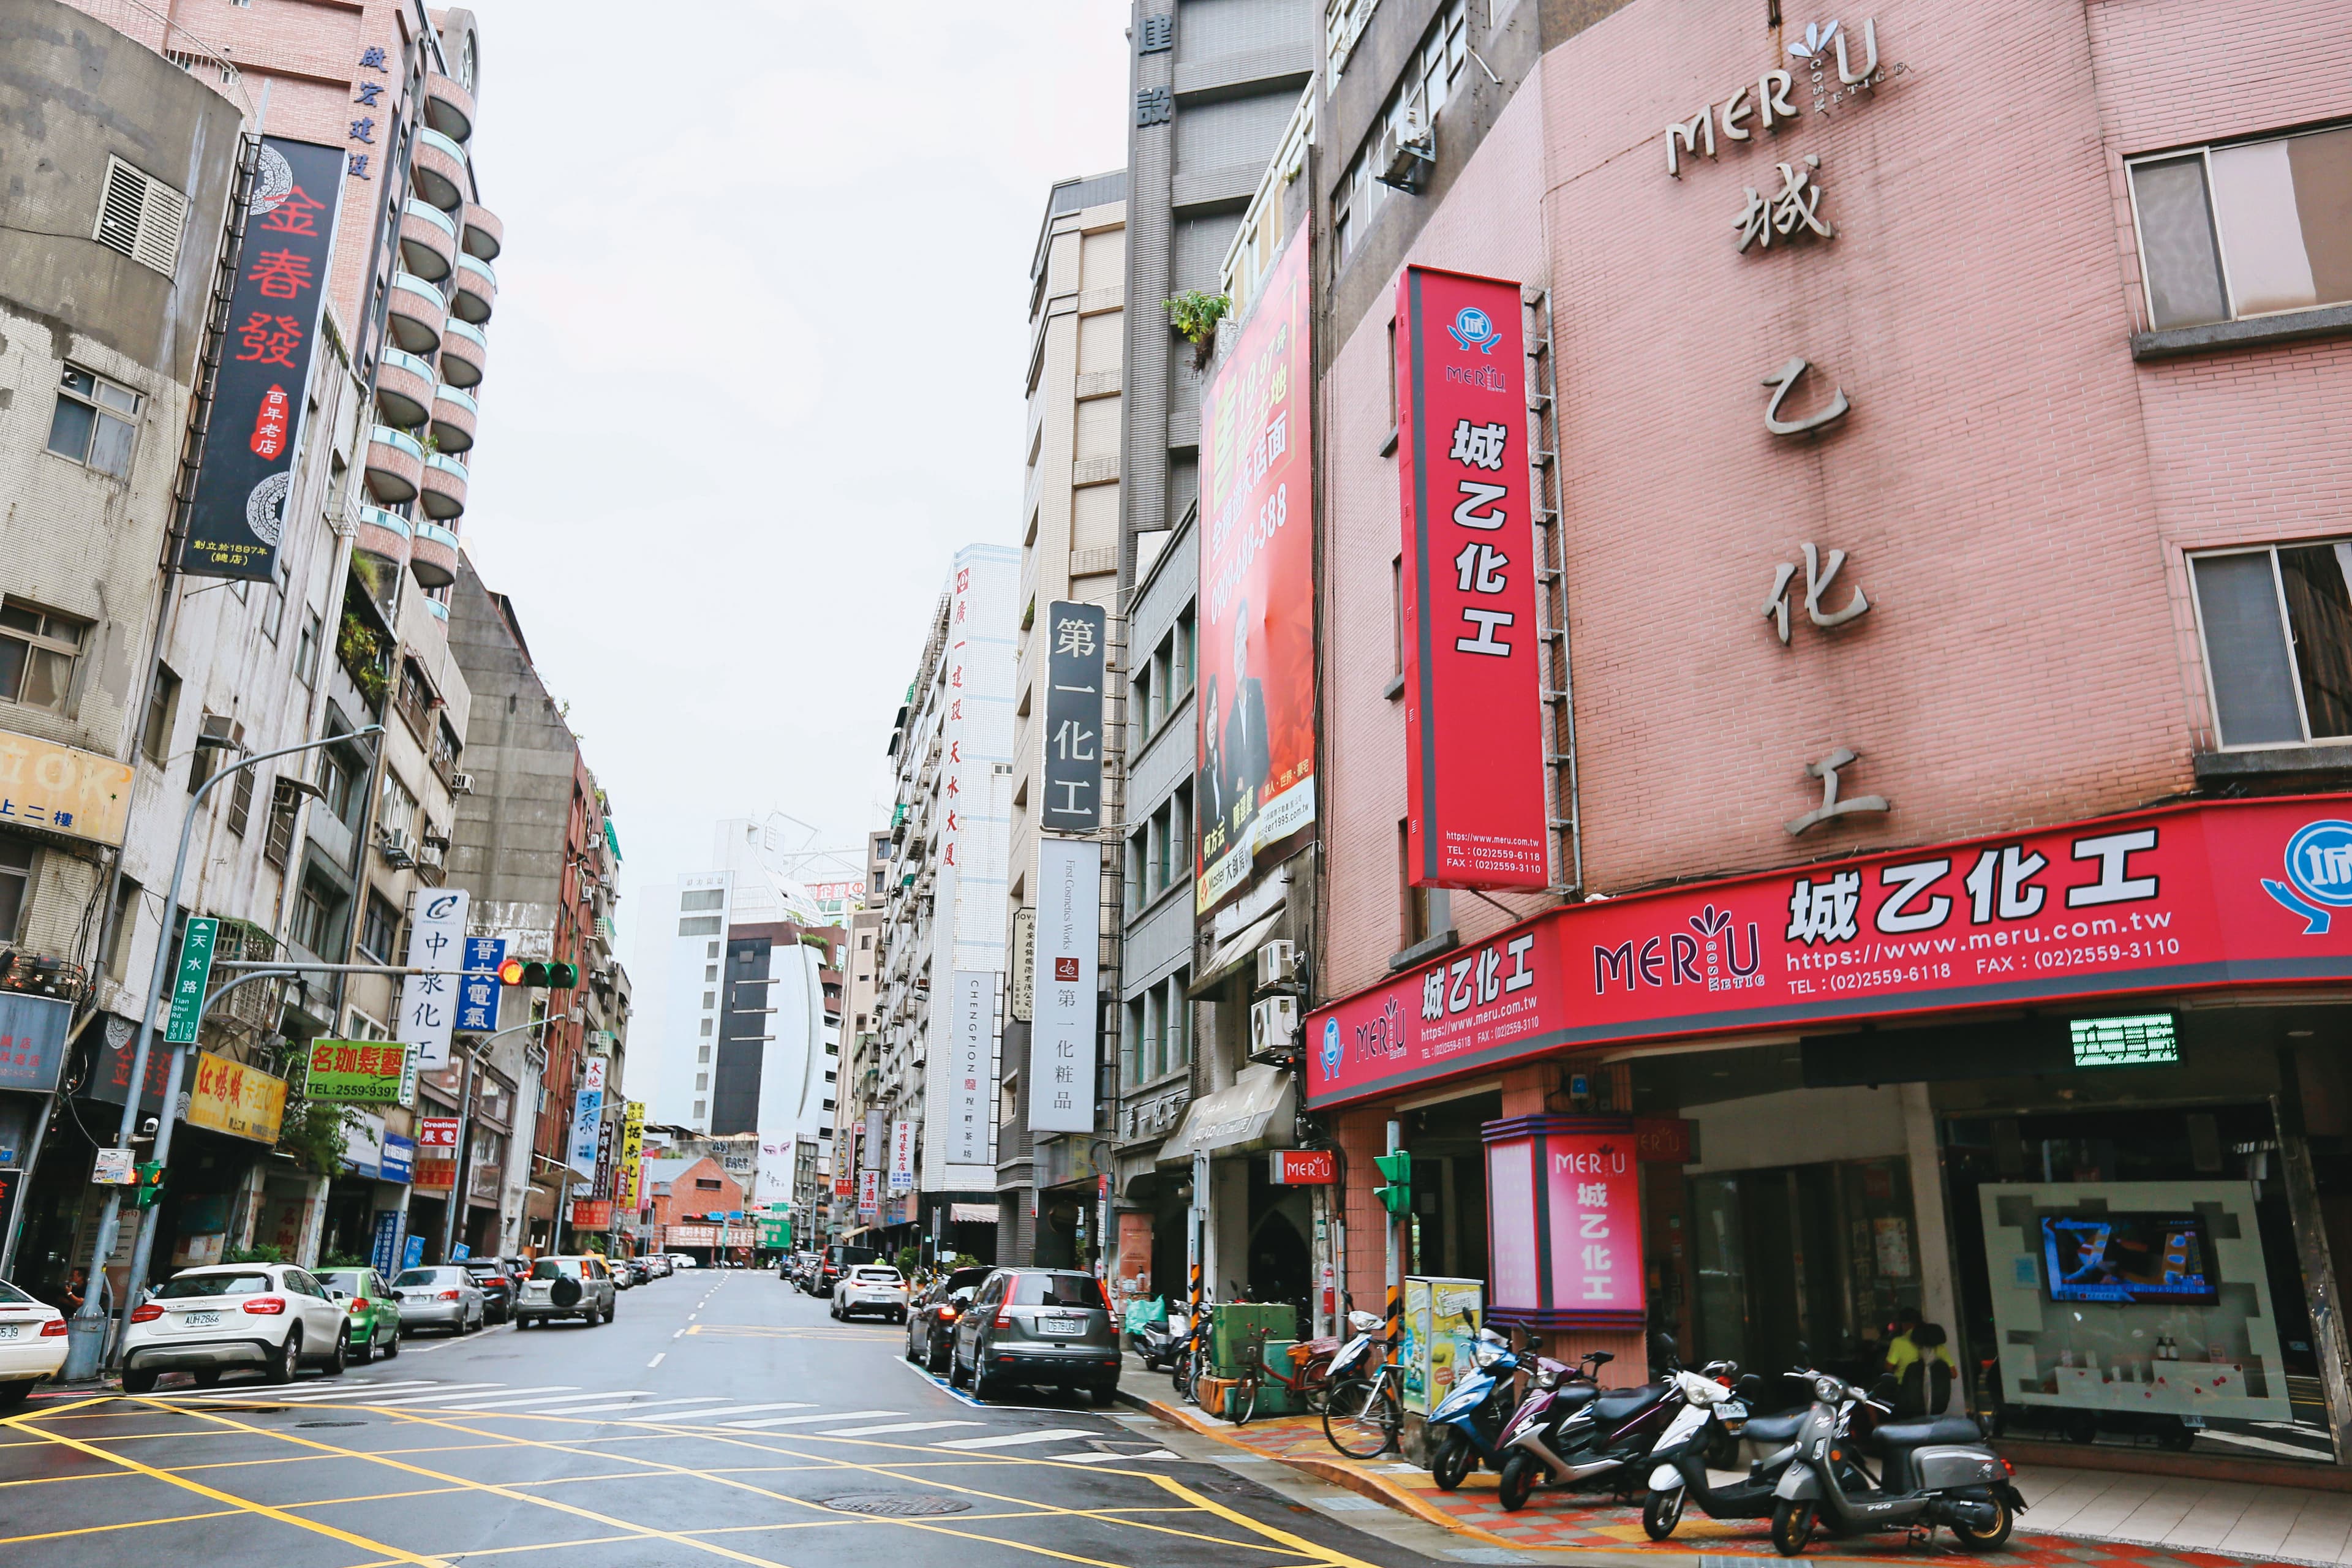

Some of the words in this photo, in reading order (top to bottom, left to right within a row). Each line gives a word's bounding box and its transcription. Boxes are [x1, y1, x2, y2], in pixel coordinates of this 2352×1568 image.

[236, 185, 328, 369] 金春發
[256, 390, 288, 454] 百年老店
[1210, 483, 1287, 626] 0909-688-588
[1449, 419, 1515, 658] 城乙化工
[1050, 617, 1097, 816] 第一化工
[942, 741, 960, 867] 天水大廈
[1066, 860, 1076, 878] First
[1446, 830, 1540, 848] https://www.meru.com.tw
[1472, 846, 1540, 862] (02)2559-6118
[1475, 859, 1541, 873] (02)2559-3110
[1063, 880, 1074, 922] Cosmetics
[1785, 827, 2160, 948] 城乙化工
[181, 934, 208, 994] 天水路
[1063, 923, 1073, 951] Works
[1786, 911, 2173, 972] https://www.meru.com.tw
[1830, 963, 1951, 993] (02)2559-6118
[2034, 937, 2180, 971] (02)2559-3110
[412, 930, 449, 1060] 中泉化工
[1421, 932, 1534, 1022] 城乙化工
[967, 980, 979, 1072] CHENGPION
[1421, 994, 1538, 1042] https://www.meru.com.tw
[1434, 1038, 1471, 1057] (02)2559-6118
[1494, 1016, 1539, 1040] (02)2559-3110
[311, 1044, 404, 1076] 名珈髮藝
[1054, 989, 1076, 1110] 第一化粧品
[862, 1172, 876, 1201] 洋酒
[1577, 1182, 1614, 1300] 城乙化工
